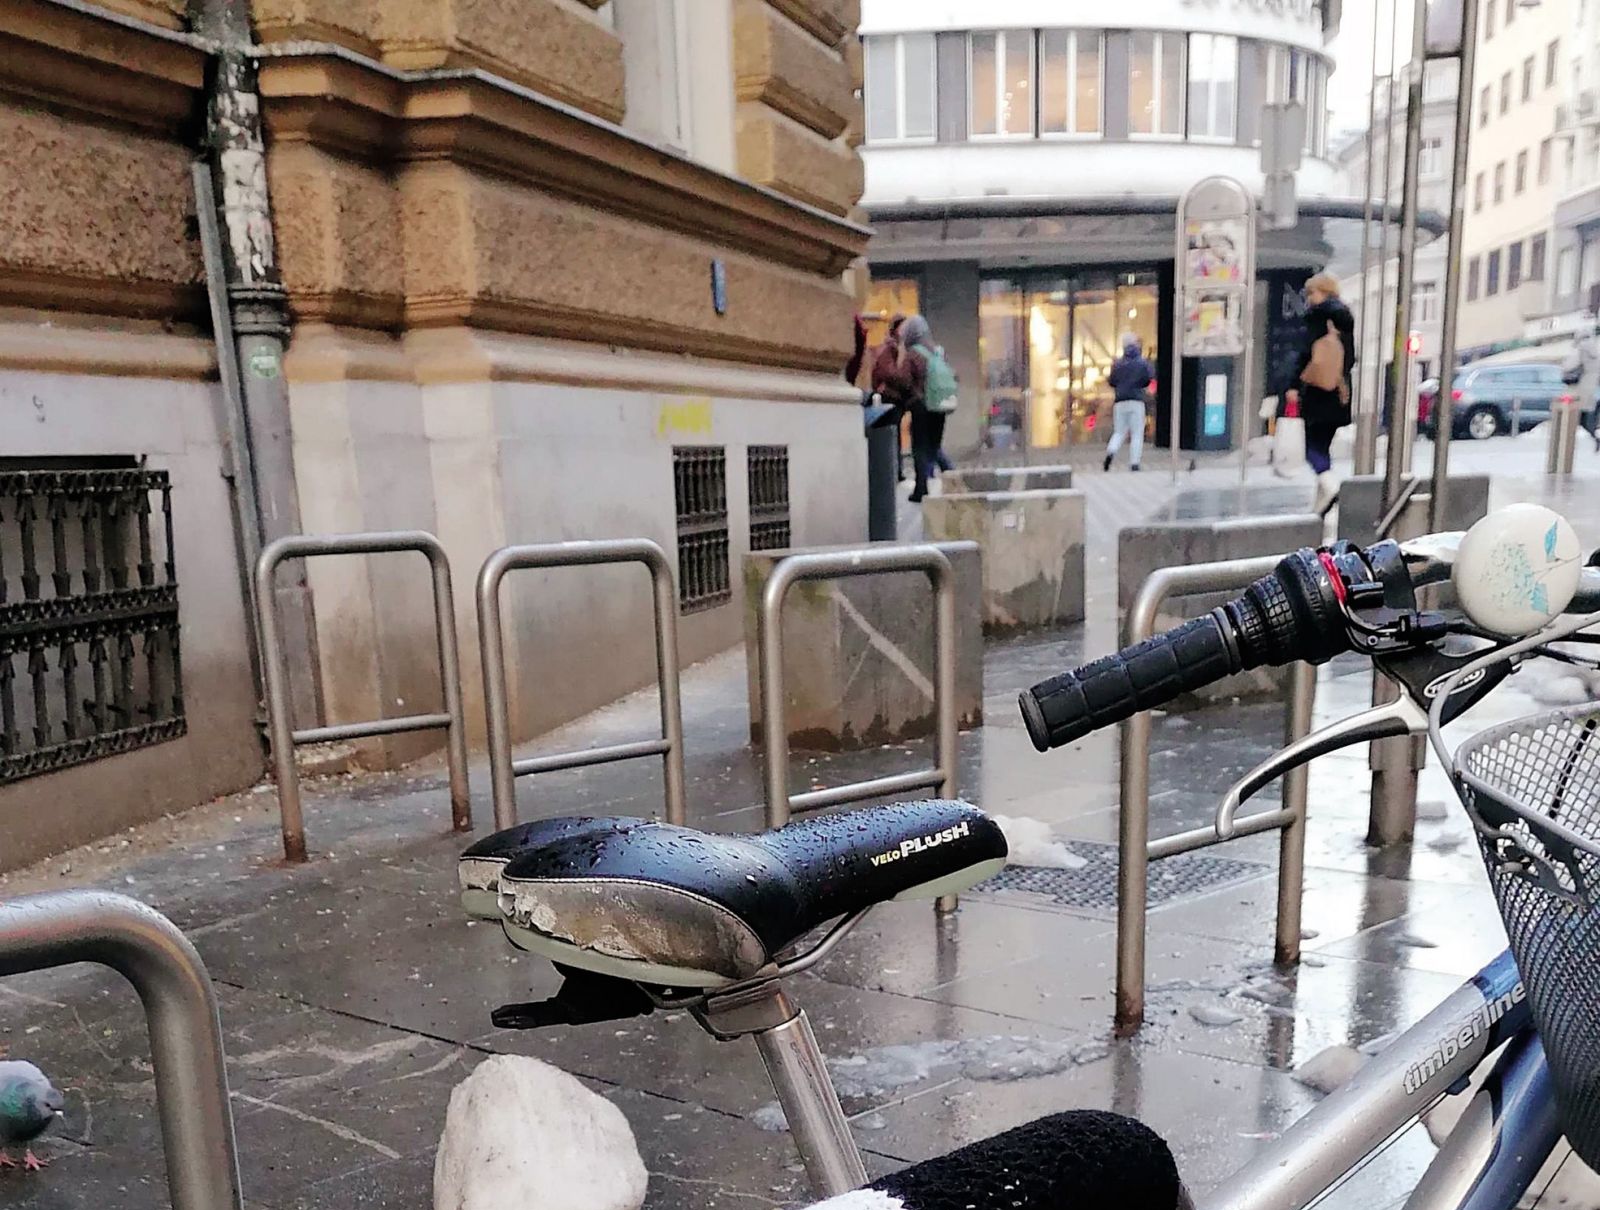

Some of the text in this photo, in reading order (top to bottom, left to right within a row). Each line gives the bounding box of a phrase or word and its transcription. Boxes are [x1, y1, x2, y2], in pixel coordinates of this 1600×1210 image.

[870, 821, 970, 867] VELO PLUSH
[1403, 980, 1527, 1095] timberline
